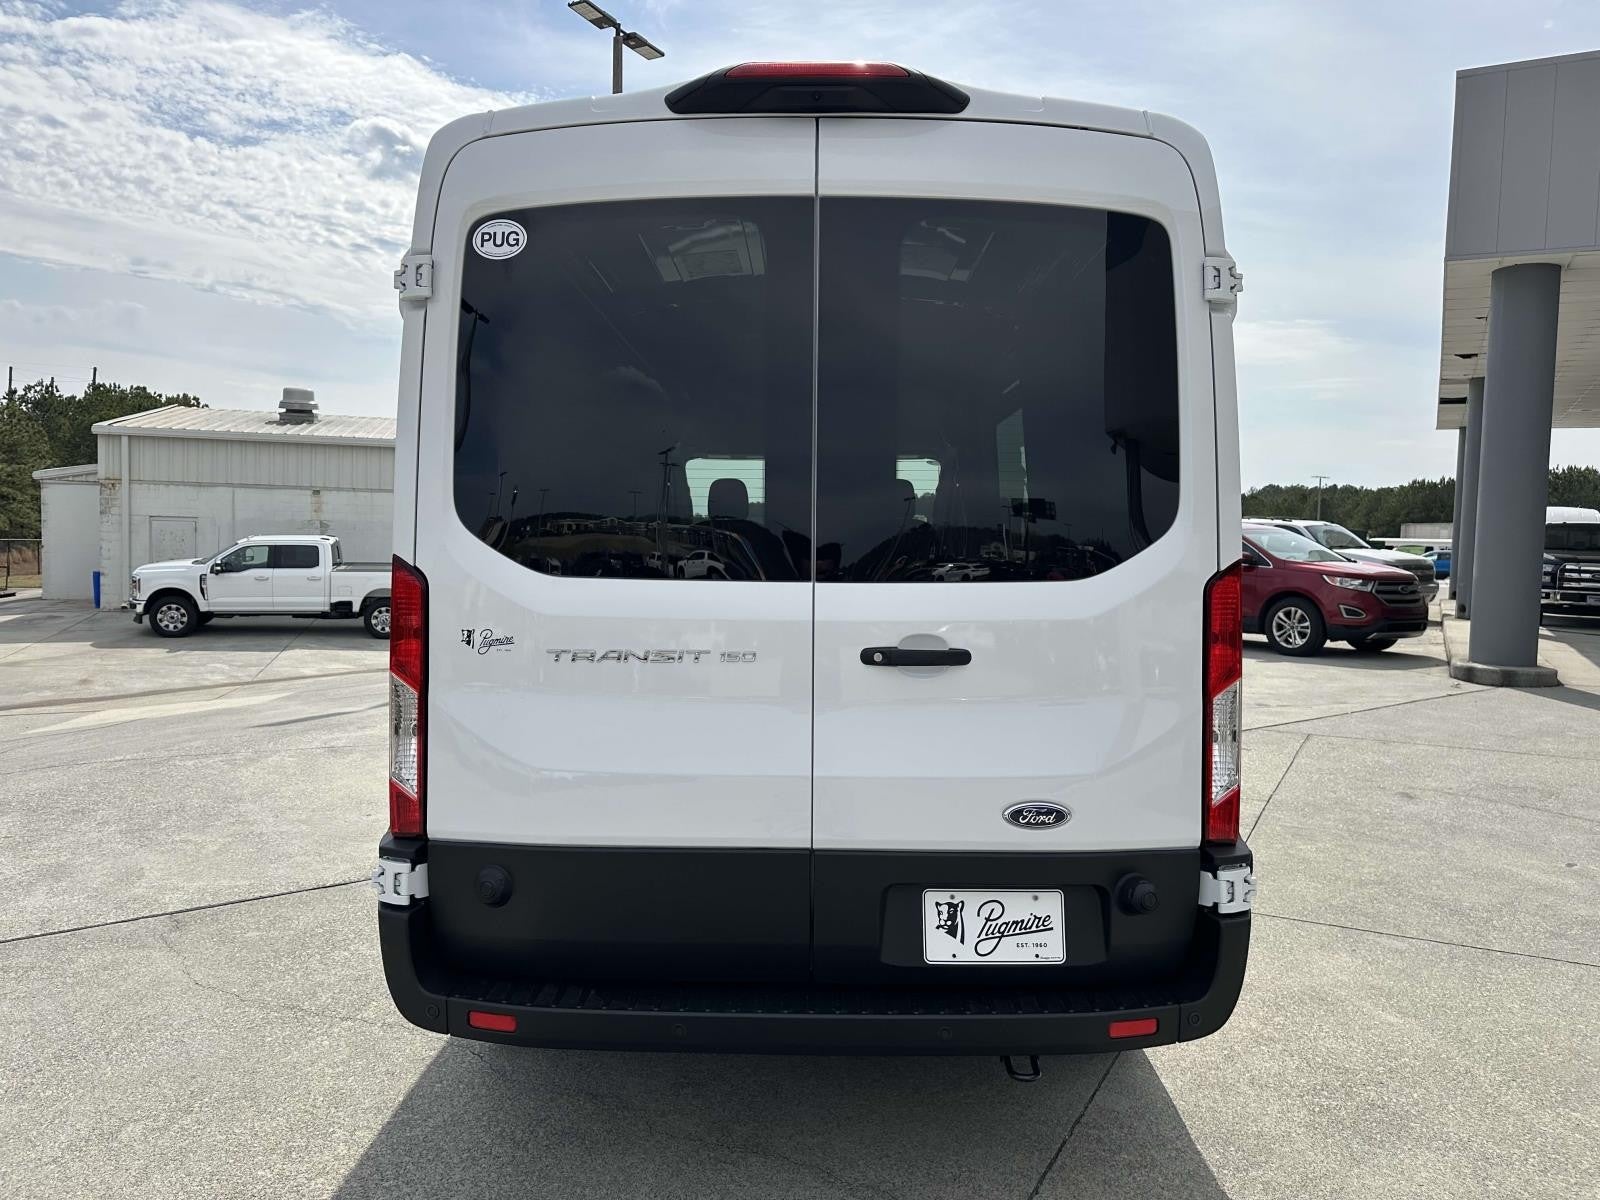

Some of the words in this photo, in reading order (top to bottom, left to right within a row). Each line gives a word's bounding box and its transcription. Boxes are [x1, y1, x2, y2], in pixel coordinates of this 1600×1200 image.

[480, 230, 520, 248] PUG
[477, 628, 515, 655] Pugmire
[546, 649, 712, 664] TRANSIT
[719, 651, 757, 663] 150
[1019, 808, 1056, 823] Ford
[974, 899, 1054, 957] Pugmire
